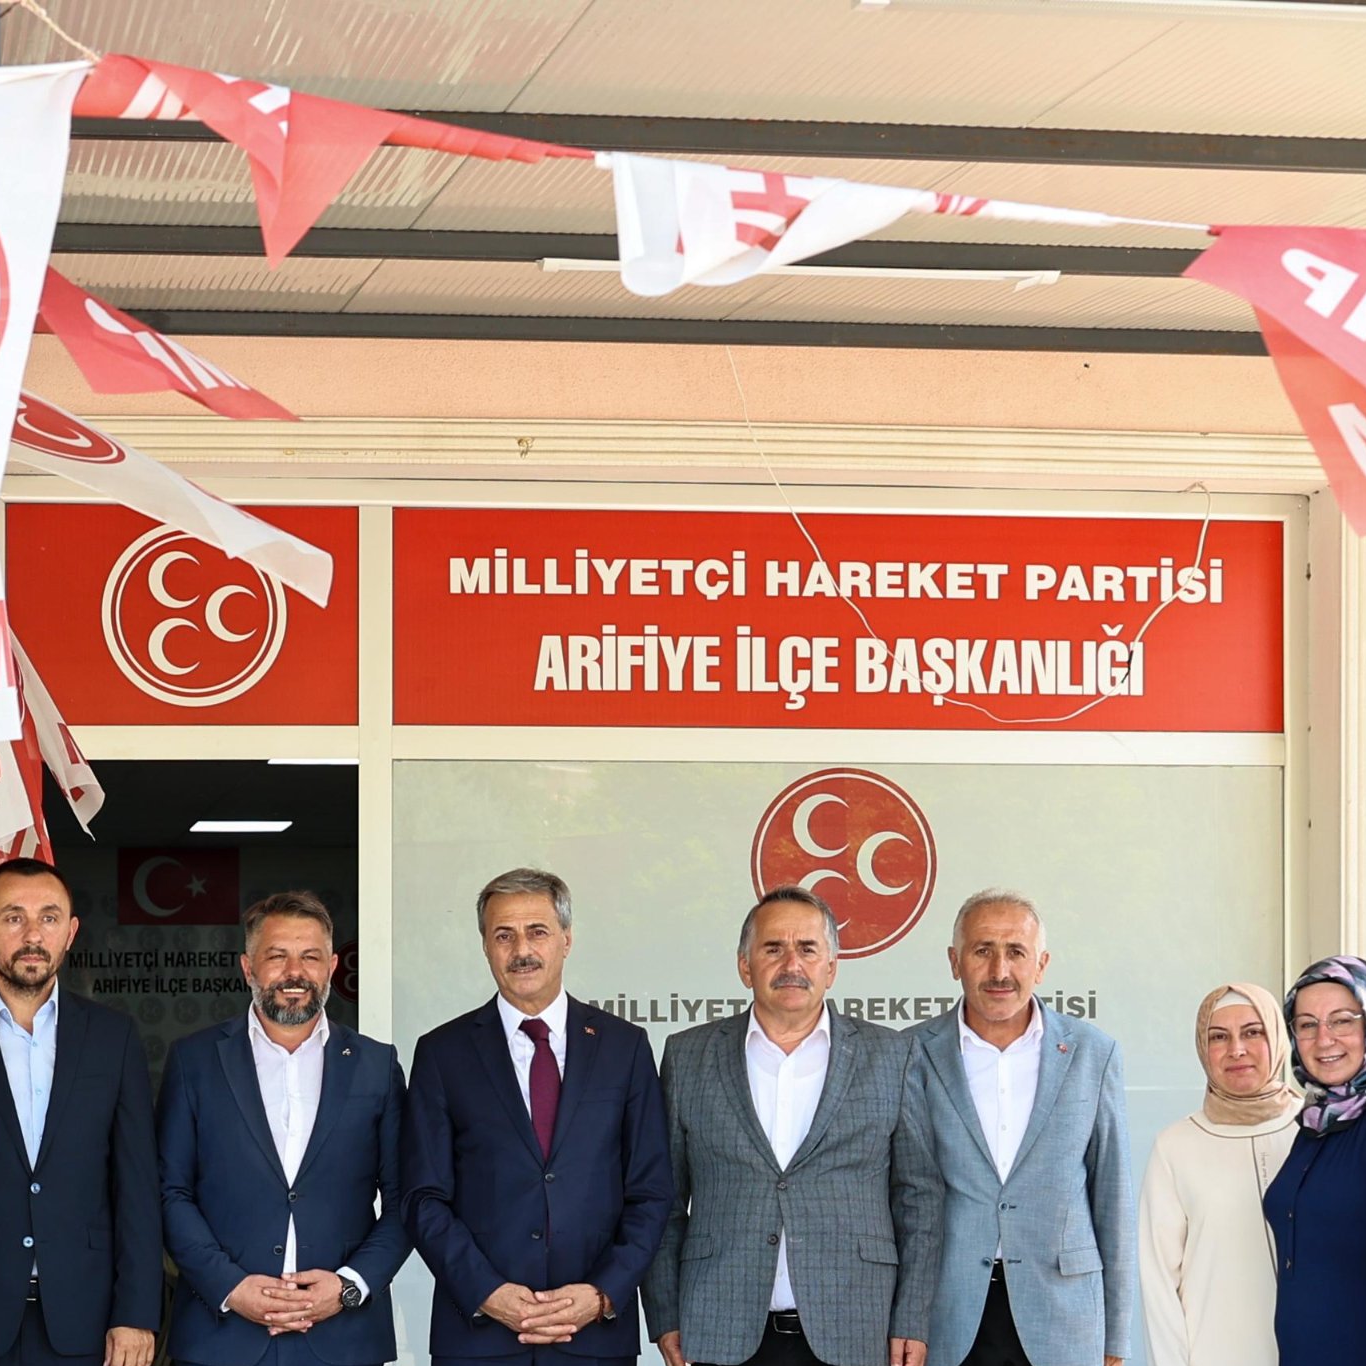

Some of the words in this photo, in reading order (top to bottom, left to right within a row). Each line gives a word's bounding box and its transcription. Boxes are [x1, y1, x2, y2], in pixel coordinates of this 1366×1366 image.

[448, 547, 746, 600] MİLLİYETÇİ
[765, 560, 1009, 600] HAREKET
[1025, 557, 1223, 604] PARTİSİ
[533, 624, 721, 692] ARİFİYE
[736, 624, 839, 711] İLÇE
[855, 623, 1144, 706] BAŞKANLIĞI
[68, 949, 159, 972] MİLLİYETÇİ
[164, 951, 239, 968] HAREKET
[92, 976, 151, 994] ARİFİYE
[155, 975, 188, 996] İLÇE
[588, 993, 747, 1023] MİLLİYET
